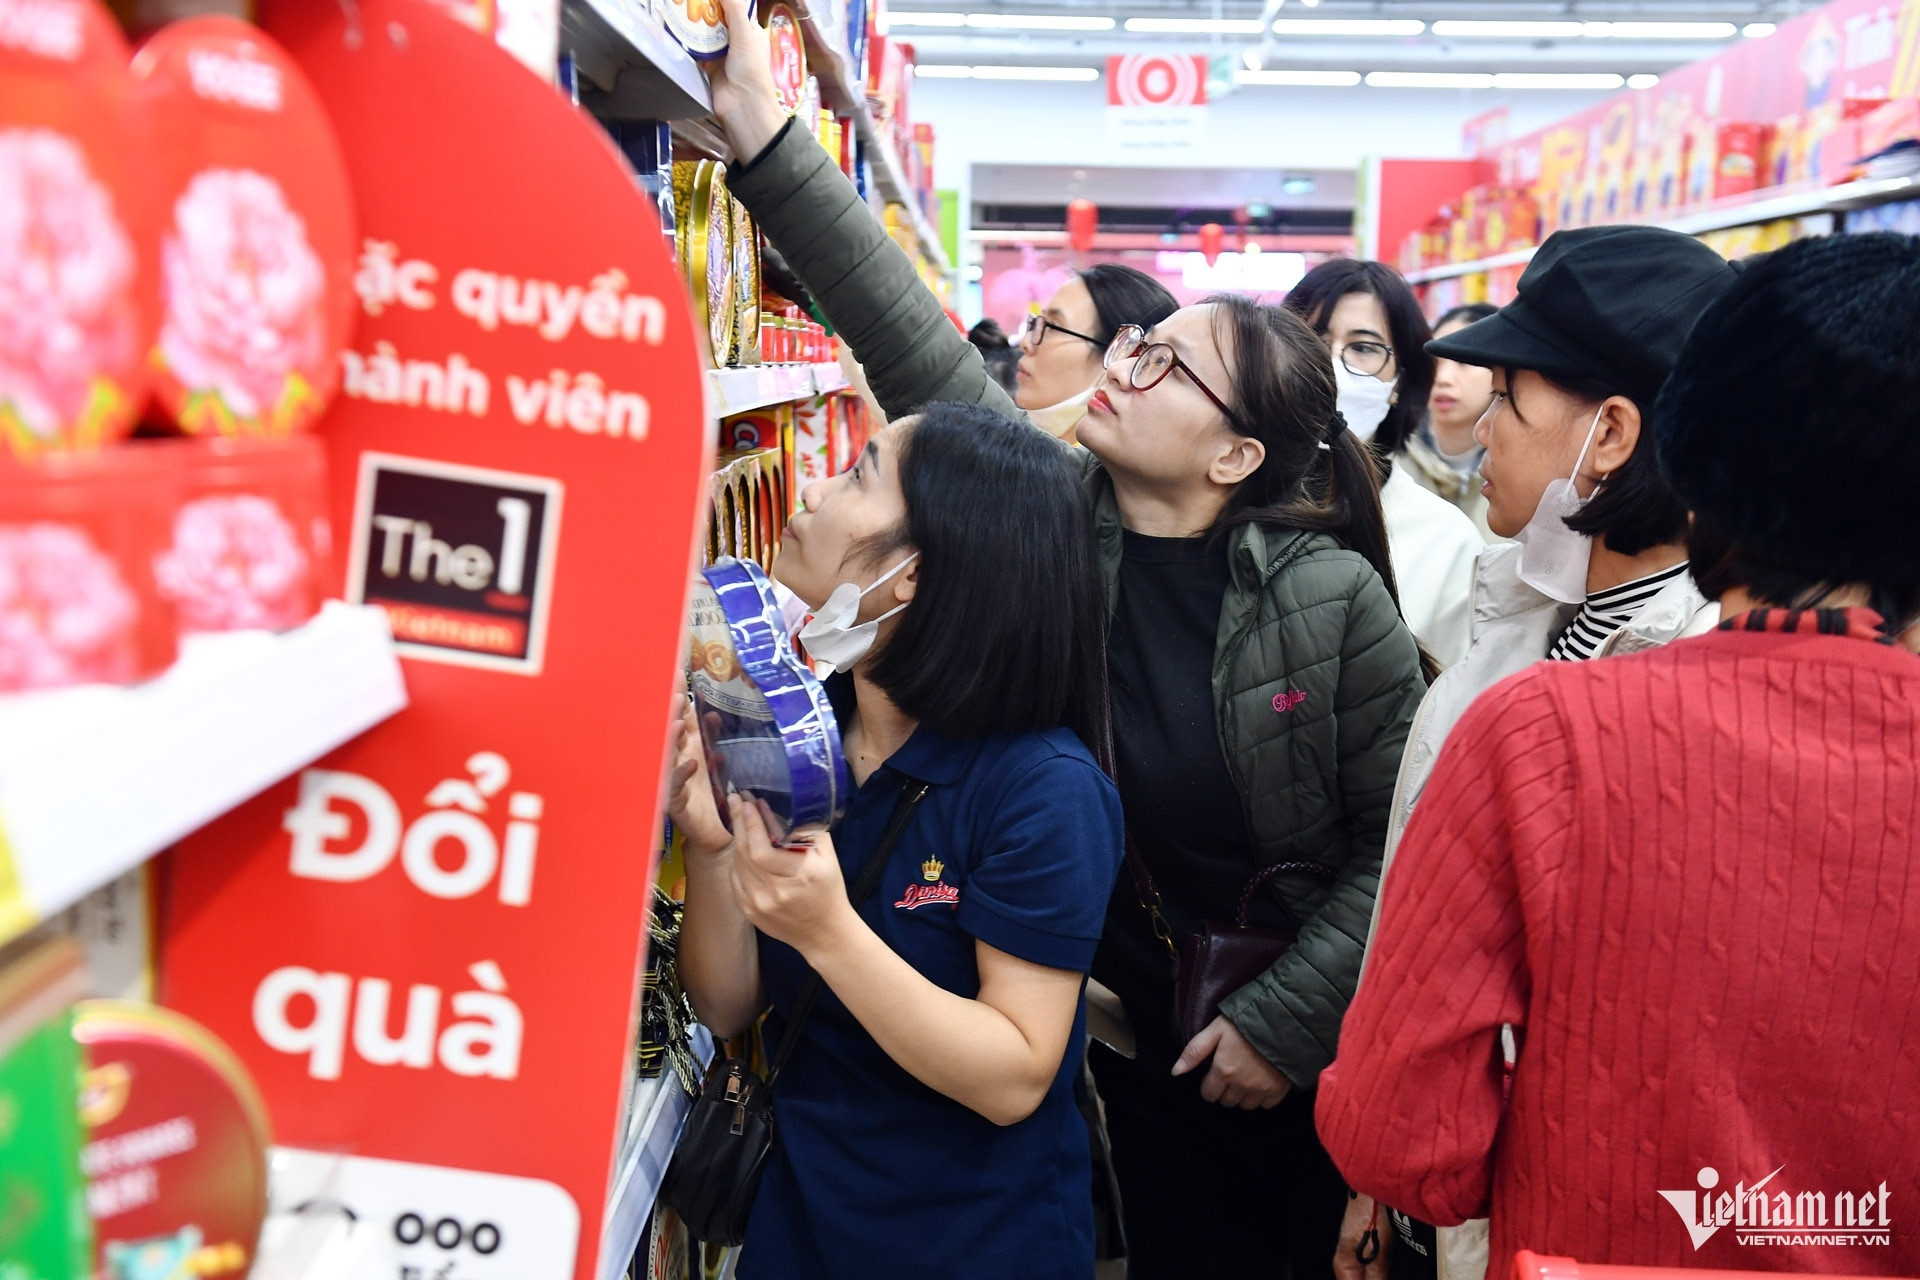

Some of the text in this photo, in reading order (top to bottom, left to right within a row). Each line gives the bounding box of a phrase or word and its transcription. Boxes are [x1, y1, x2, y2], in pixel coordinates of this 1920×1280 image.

[353, 238, 438, 317] ặc
[505, 368, 650, 441] viên
[371, 498, 531, 595] The 1
[384, 604, 515, 650] ietnam
[283, 751, 543, 906] Đổi
[893, 880, 960, 910] Danisa
[252, 960, 524, 1081] quà
